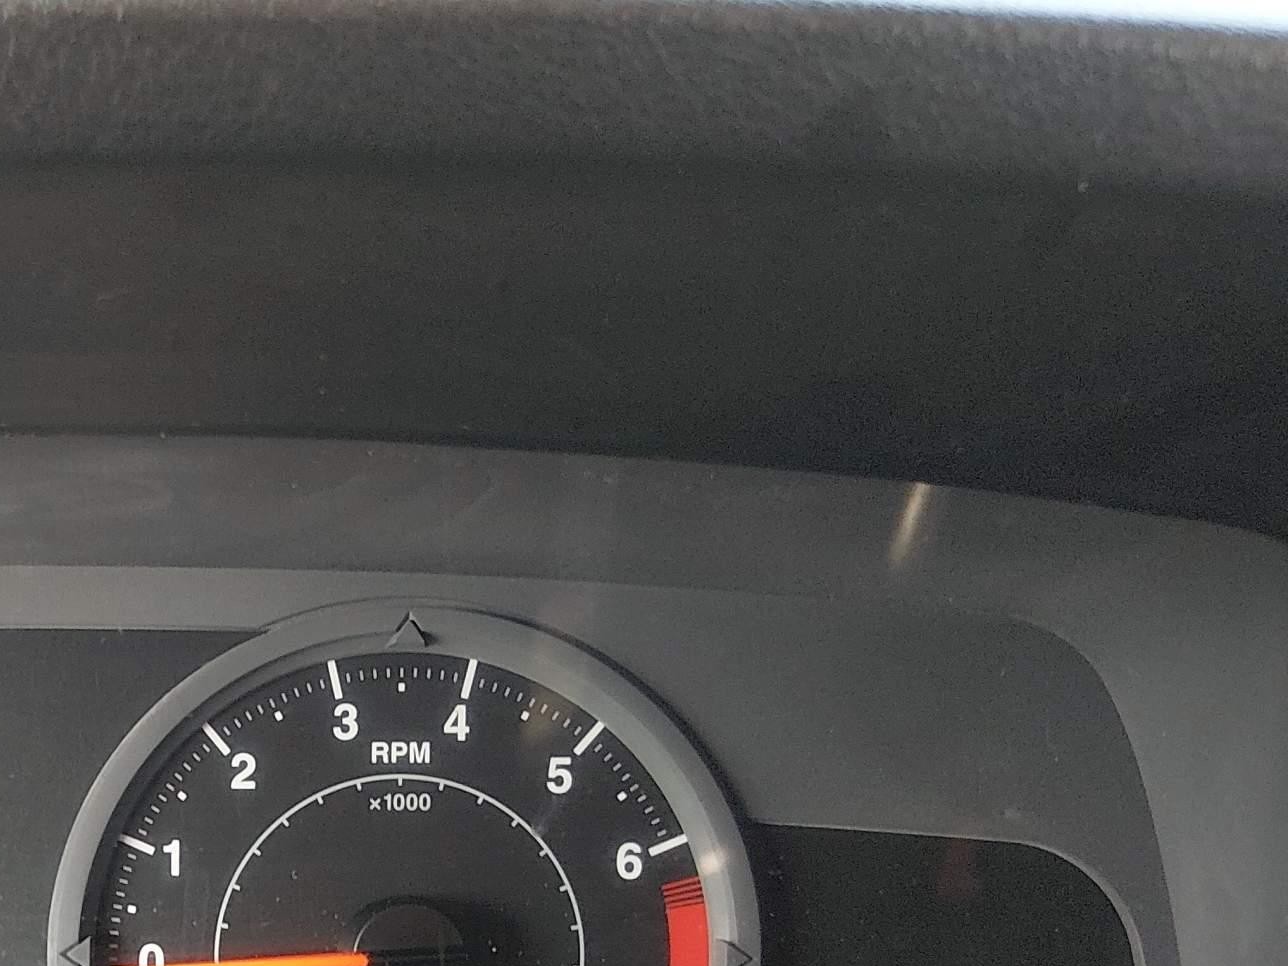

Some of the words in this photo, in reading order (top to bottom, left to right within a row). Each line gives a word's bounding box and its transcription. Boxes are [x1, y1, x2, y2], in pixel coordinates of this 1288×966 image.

[333, 702, 359, 741] 3
[443, 703, 470, 741] 4
[230, 752, 257, 790] 2
[370, 741, 431, 764] RPM
[546, 756, 573, 795] 5
[163, 839, 181, 876] 1
[615, 841, 643, 880] 6
